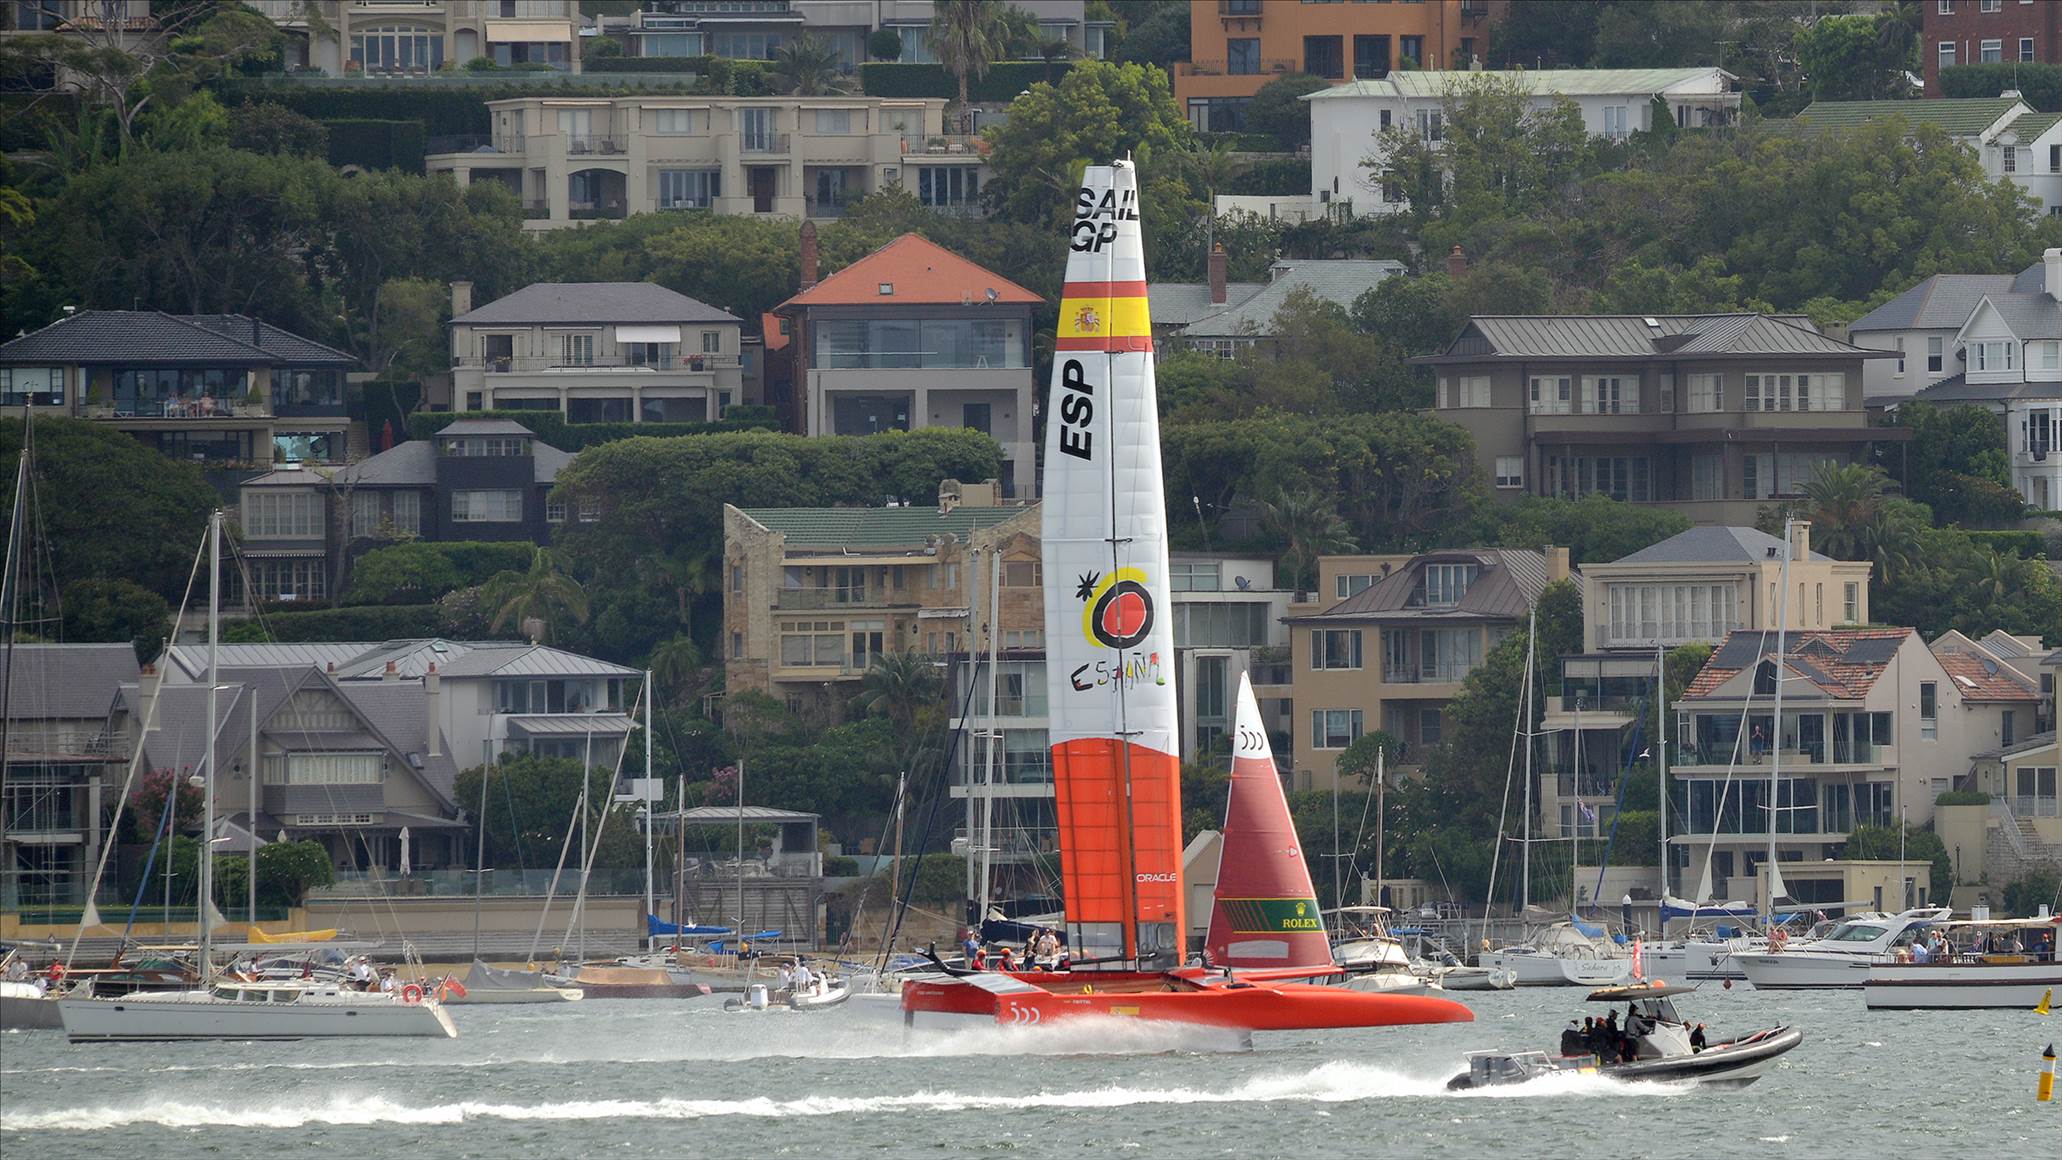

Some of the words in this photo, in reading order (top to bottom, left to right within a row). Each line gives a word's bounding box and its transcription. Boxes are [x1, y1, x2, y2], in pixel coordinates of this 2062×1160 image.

[1076, 188, 1140, 221] SAIL
[1070, 221, 1118, 253] GP
[1060, 358, 1094, 461] ESP
[1136, 873, 1177, 883] ORACLE
[1283, 918, 1318, 928] ROLEX
